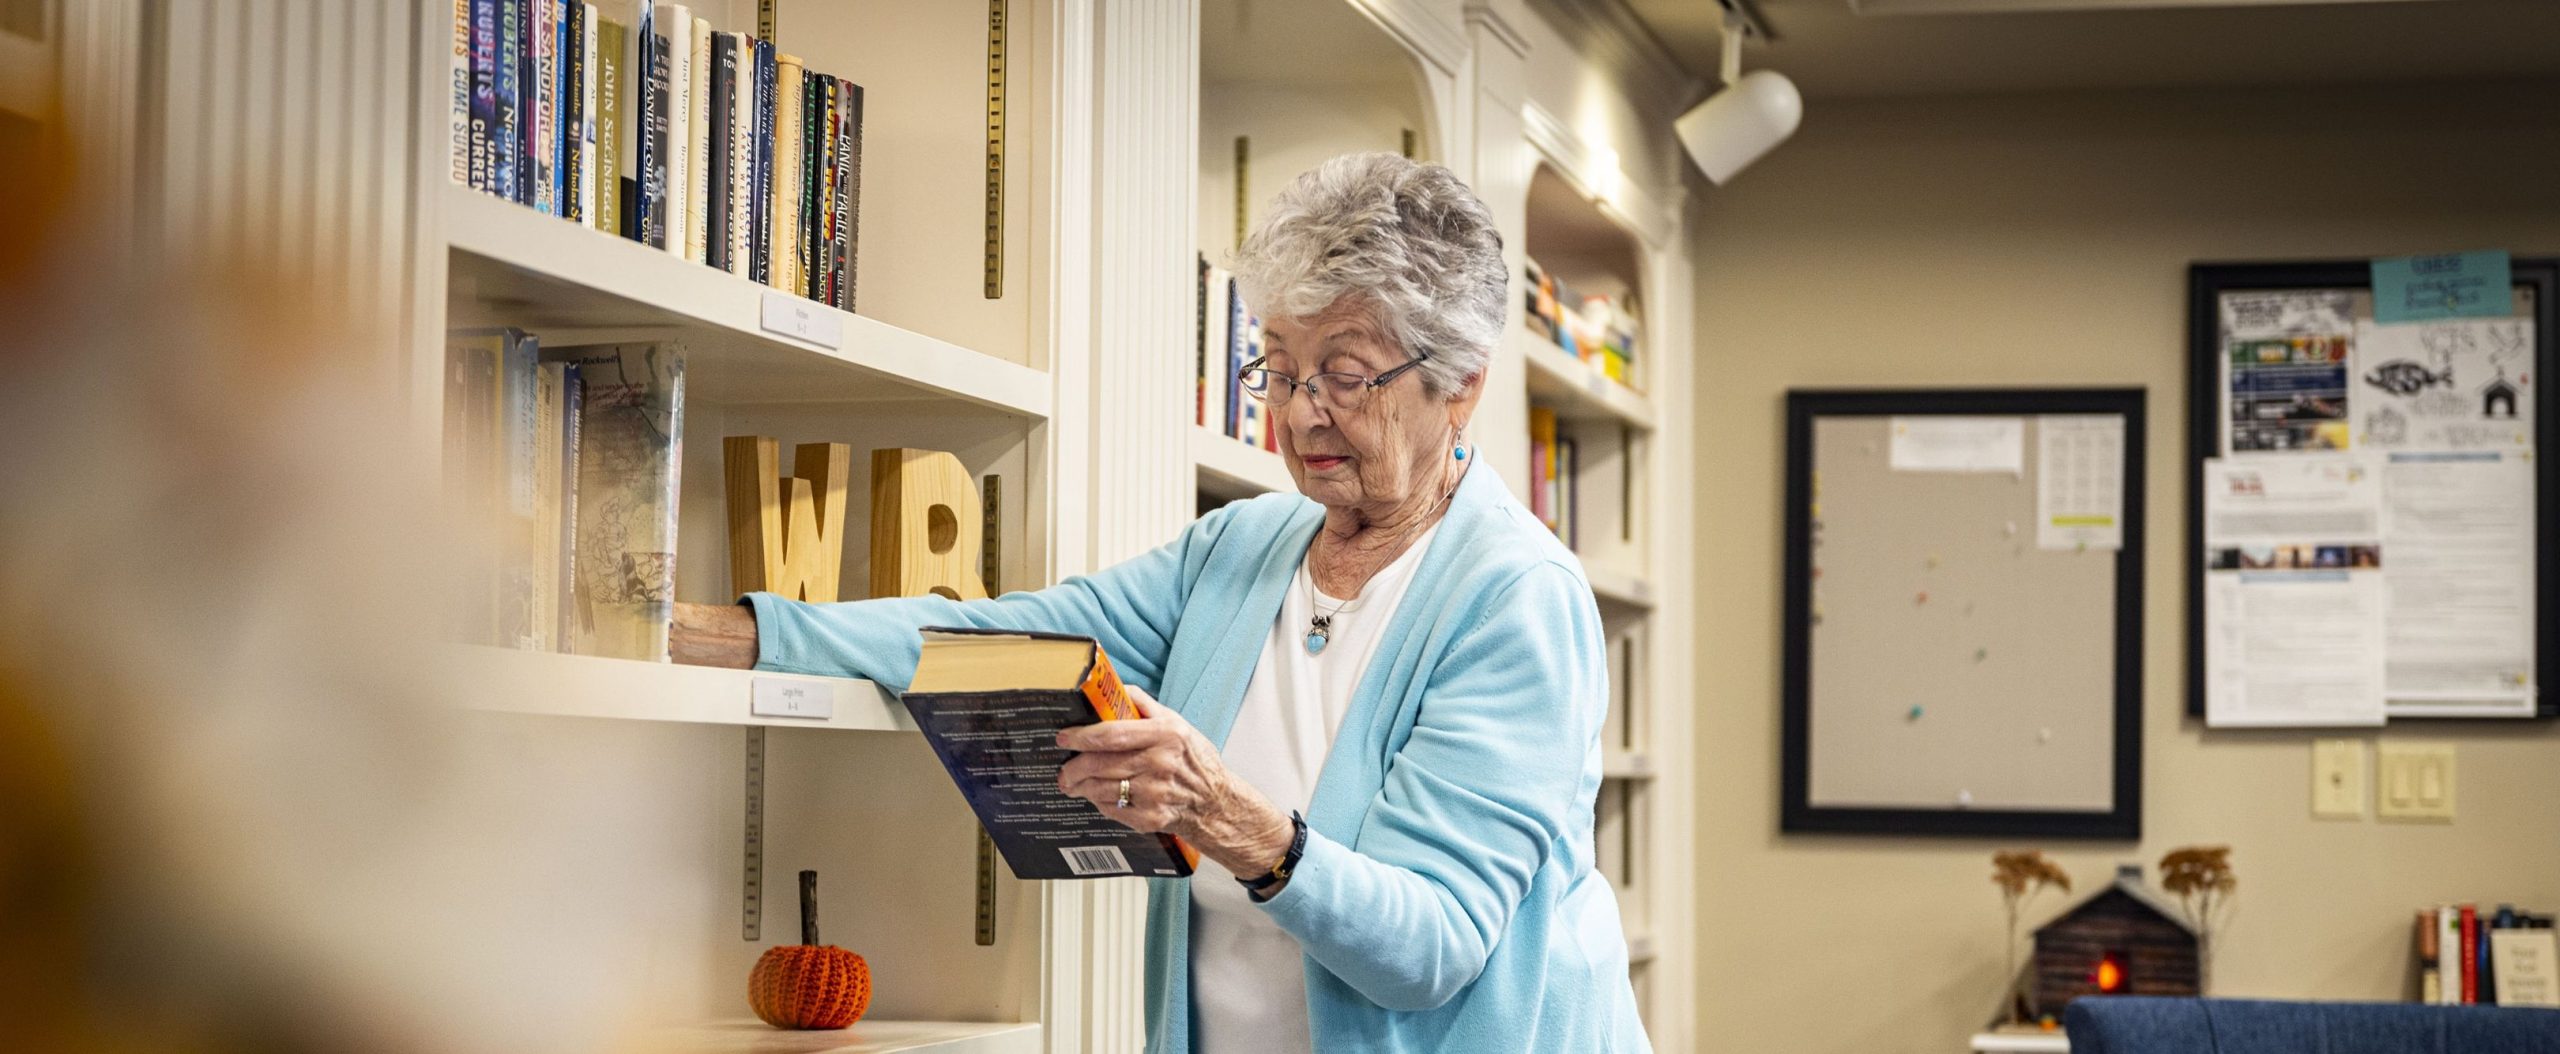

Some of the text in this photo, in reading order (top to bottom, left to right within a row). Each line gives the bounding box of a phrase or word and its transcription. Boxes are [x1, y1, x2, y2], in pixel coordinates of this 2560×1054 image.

[502, 2, 516, 90] ROBERTS
[572, 8, 583, 46] Nights
[574, 48, 581, 59] in
[604, 58, 615, 112] JOHN
[763, 66, 769, 79] OF
[807, 81, 816, 144] STUART
[826, 85, 837, 157] STUART
[571, 147, 580, 204] Nicholas
[839, 133, 851, 177] PANIC
[728, 192, 734, 205] IN
[738, 124, 747, 251] TARA WESTOVER
[805, 151, 814, 218] WOODS
[835, 192, 849, 247] PACIFIC
